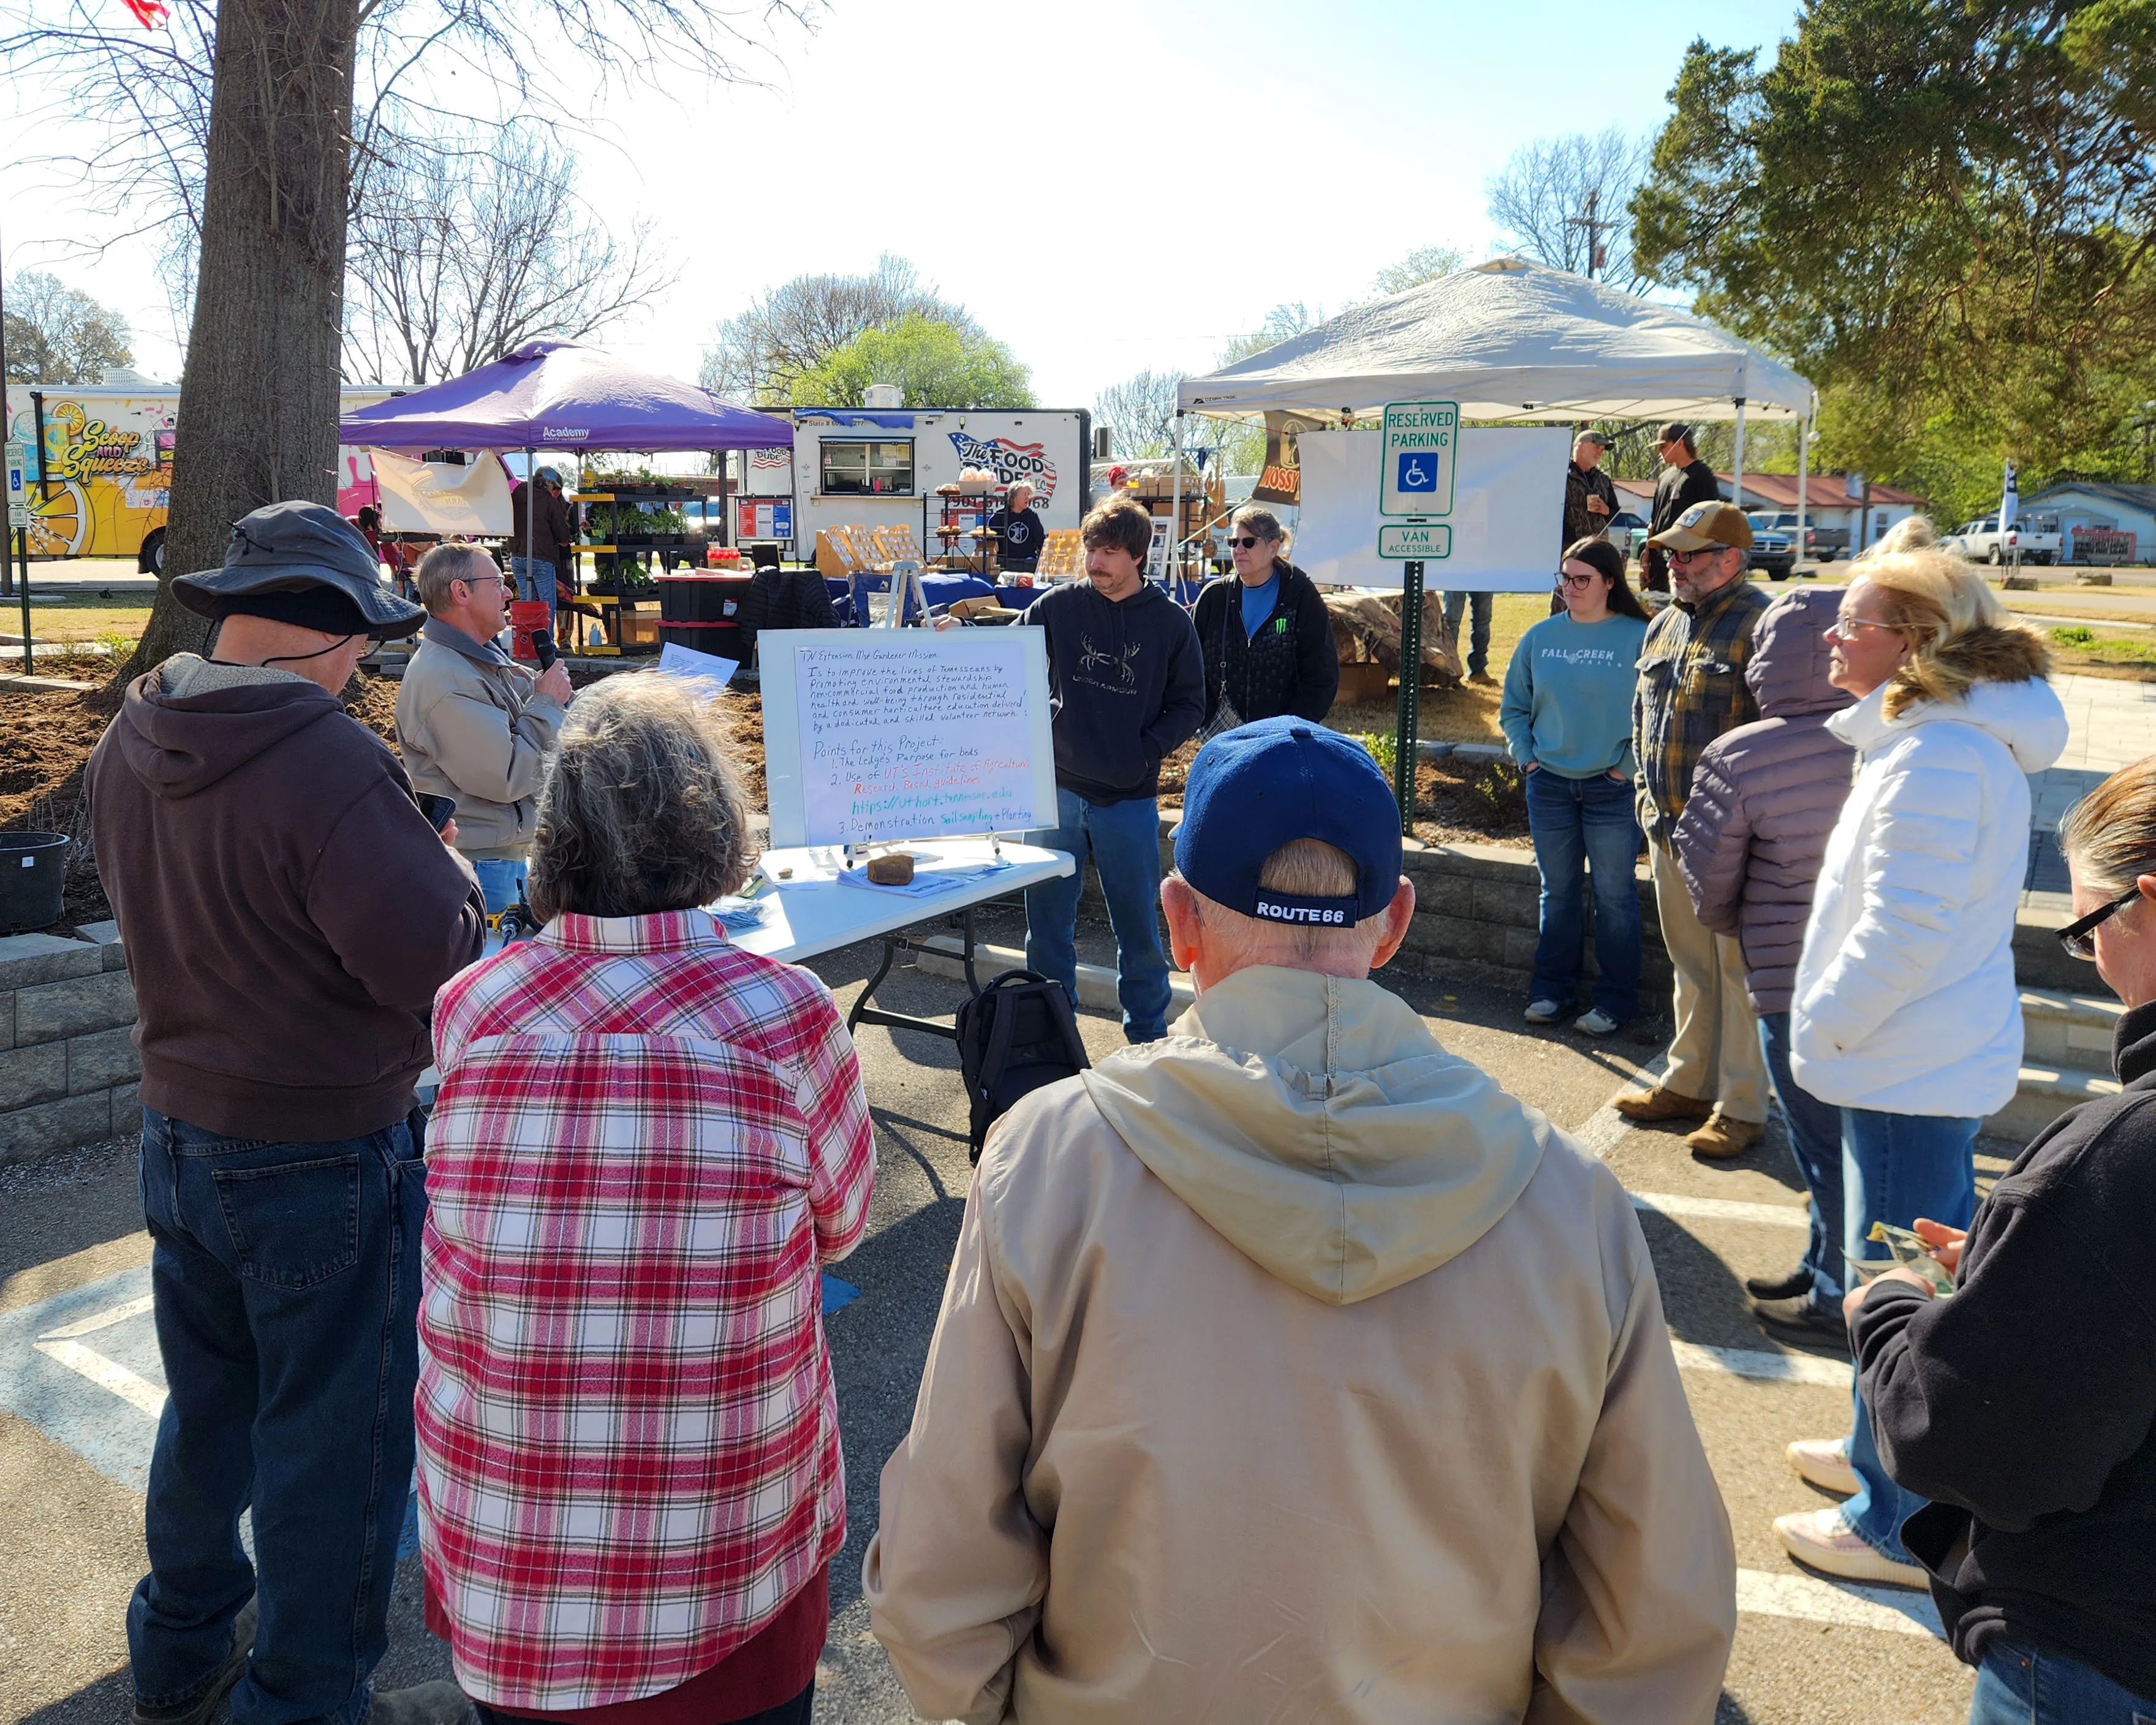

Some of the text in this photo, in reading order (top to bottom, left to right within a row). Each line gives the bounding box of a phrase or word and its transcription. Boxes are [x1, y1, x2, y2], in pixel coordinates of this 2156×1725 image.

[1388, 412, 1453, 428] RESERVED
[80, 420, 140, 453] Scoop
[543, 427, 589, 440] Academy
[1391, 432, 1448, 447] PARKING
[62, 444, 149, 486] Squeeze
[756, 451, 781, 461] DUDE
[962, 442, 1044, 473] The FOOD
[1259, 466, 1299, 492] MOSSY
[1402, 531, 1429, 542] VAN
[1389, 544, 1441, 553] ACCESSIBLE
[800, 650, 817, 662] TN
[819, 651, 853, 661] Extension
[873, 650, 906, 660] Gardener
[1541, 648, 1614, 660] FALL CREEK
[808, 667, 822, 677] Is
[827, 667, 836, 677] to
[839, 667, 877, 678] improve
[881, 667, 897, 675] the
[994, 664, 1004, 674] by
[861, 675, 931, 686] environmental
[883, 686, 903, 694] food
[907, 684, 956, 696] production
[1073, 675, 1137, 695] UNDER ARMOUR
[811, 698, 841, 710] health
[911, 693, 948, 705] through
[953, 690, 1007, 700] residential
[812, 697, 1023, 719] and consumer horticulture education delivered
[814, 719, 822, 734] by
[835, 718, 880, 729] dedicated
[905, 713, 934, 723] skilled
[940, 711, 980, 721] volunteer
[814, 741, 847, 759] Points
[850, 739, 868, 754] for
[871, 737, 893, 753] this
[839, 757, 855, 767] The
[940, 750, 956, 759] for
[959, 746, 979, 756] beds
[846, 772, 863, 783] Use
[868, 770, 880, 780] of
[913, 762, 965, 776] Institute
[970, 760, 981, 772] of
[854, 775, 980, 795] Research Based guidelines
[851, 813, 934, 832] Demonstration
[940, 809, 957, 824] Soil
[1002, 806, 1032, 822] Planting
